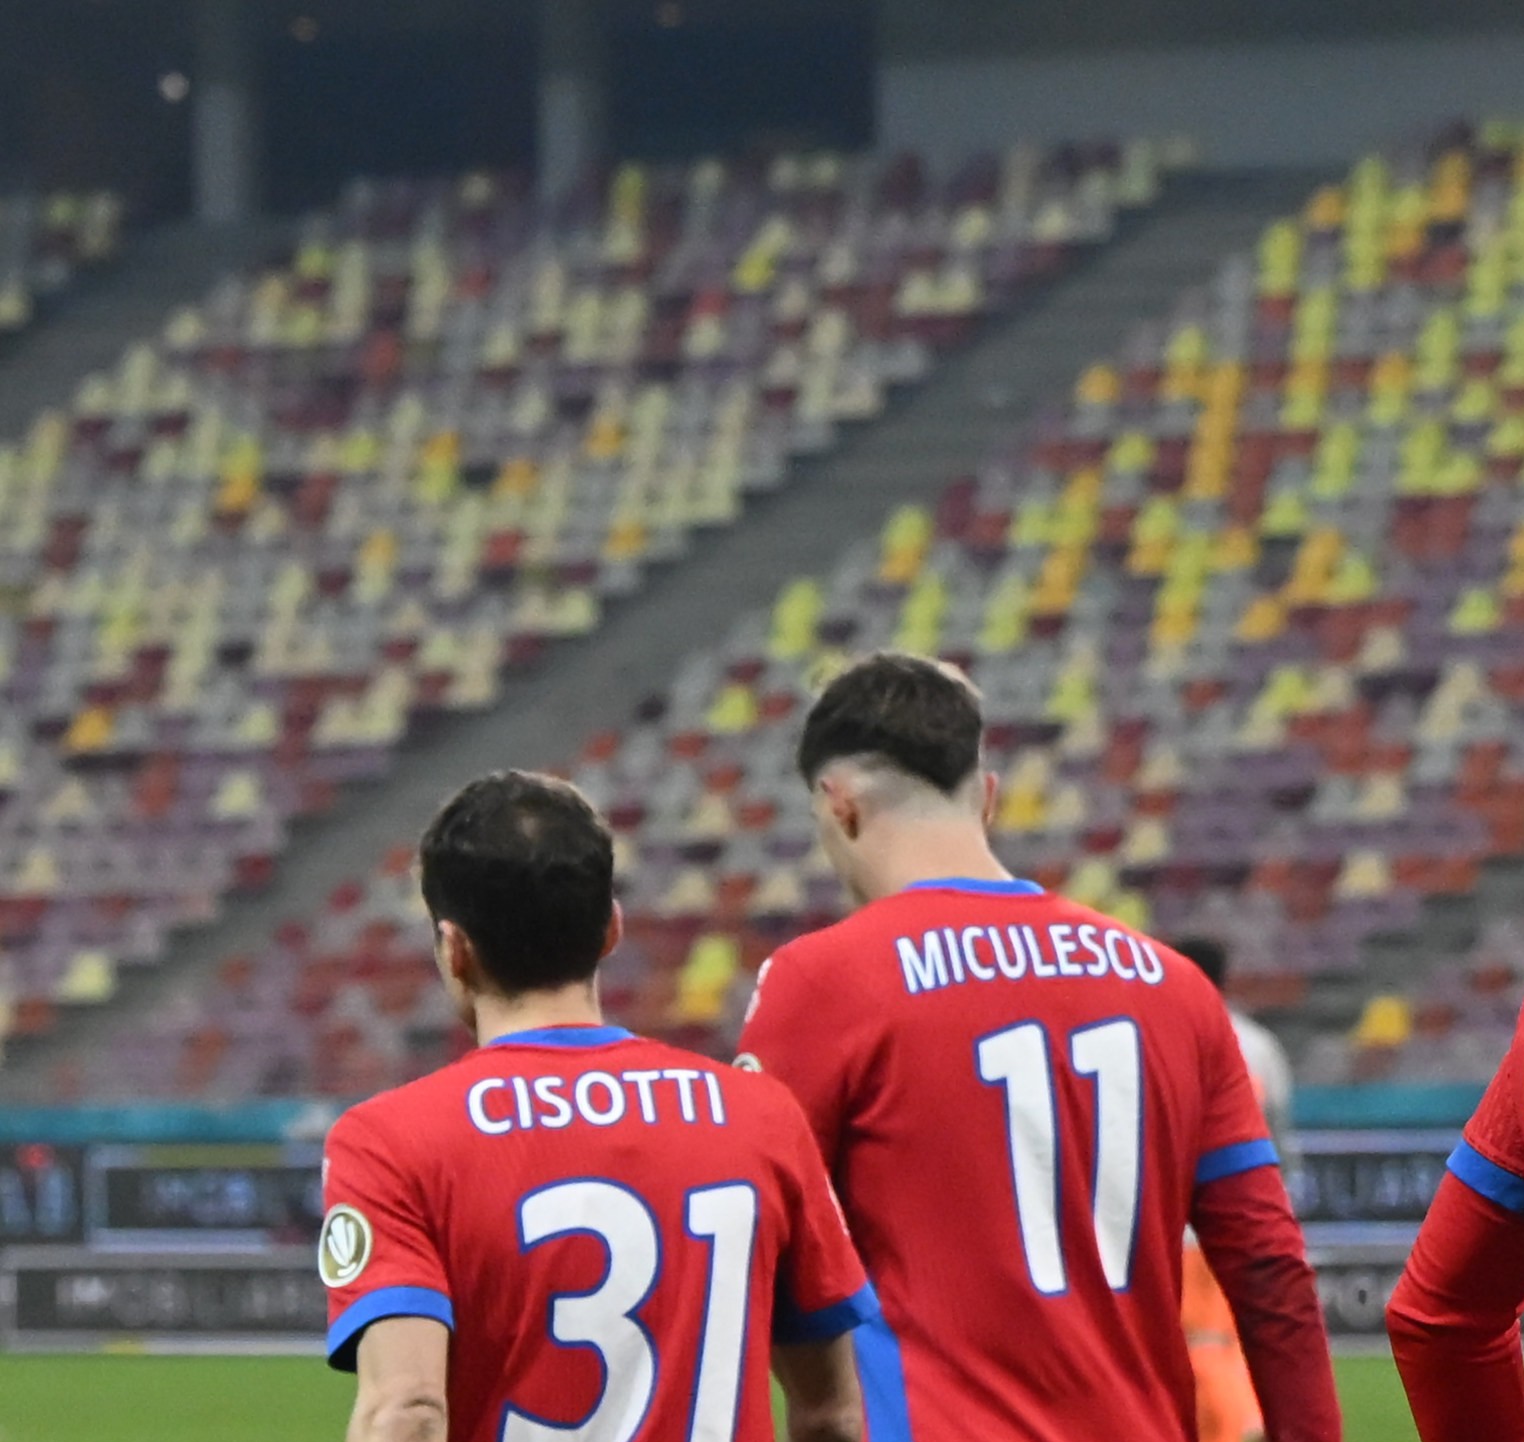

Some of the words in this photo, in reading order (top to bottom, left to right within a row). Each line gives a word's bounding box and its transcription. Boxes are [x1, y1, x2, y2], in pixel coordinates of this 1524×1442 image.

[895, 922, 1165, 994] MICULESCU
[466, 1067, 727, 1136] CISOTTI
[976, 1015, 1144, 1297] 11
